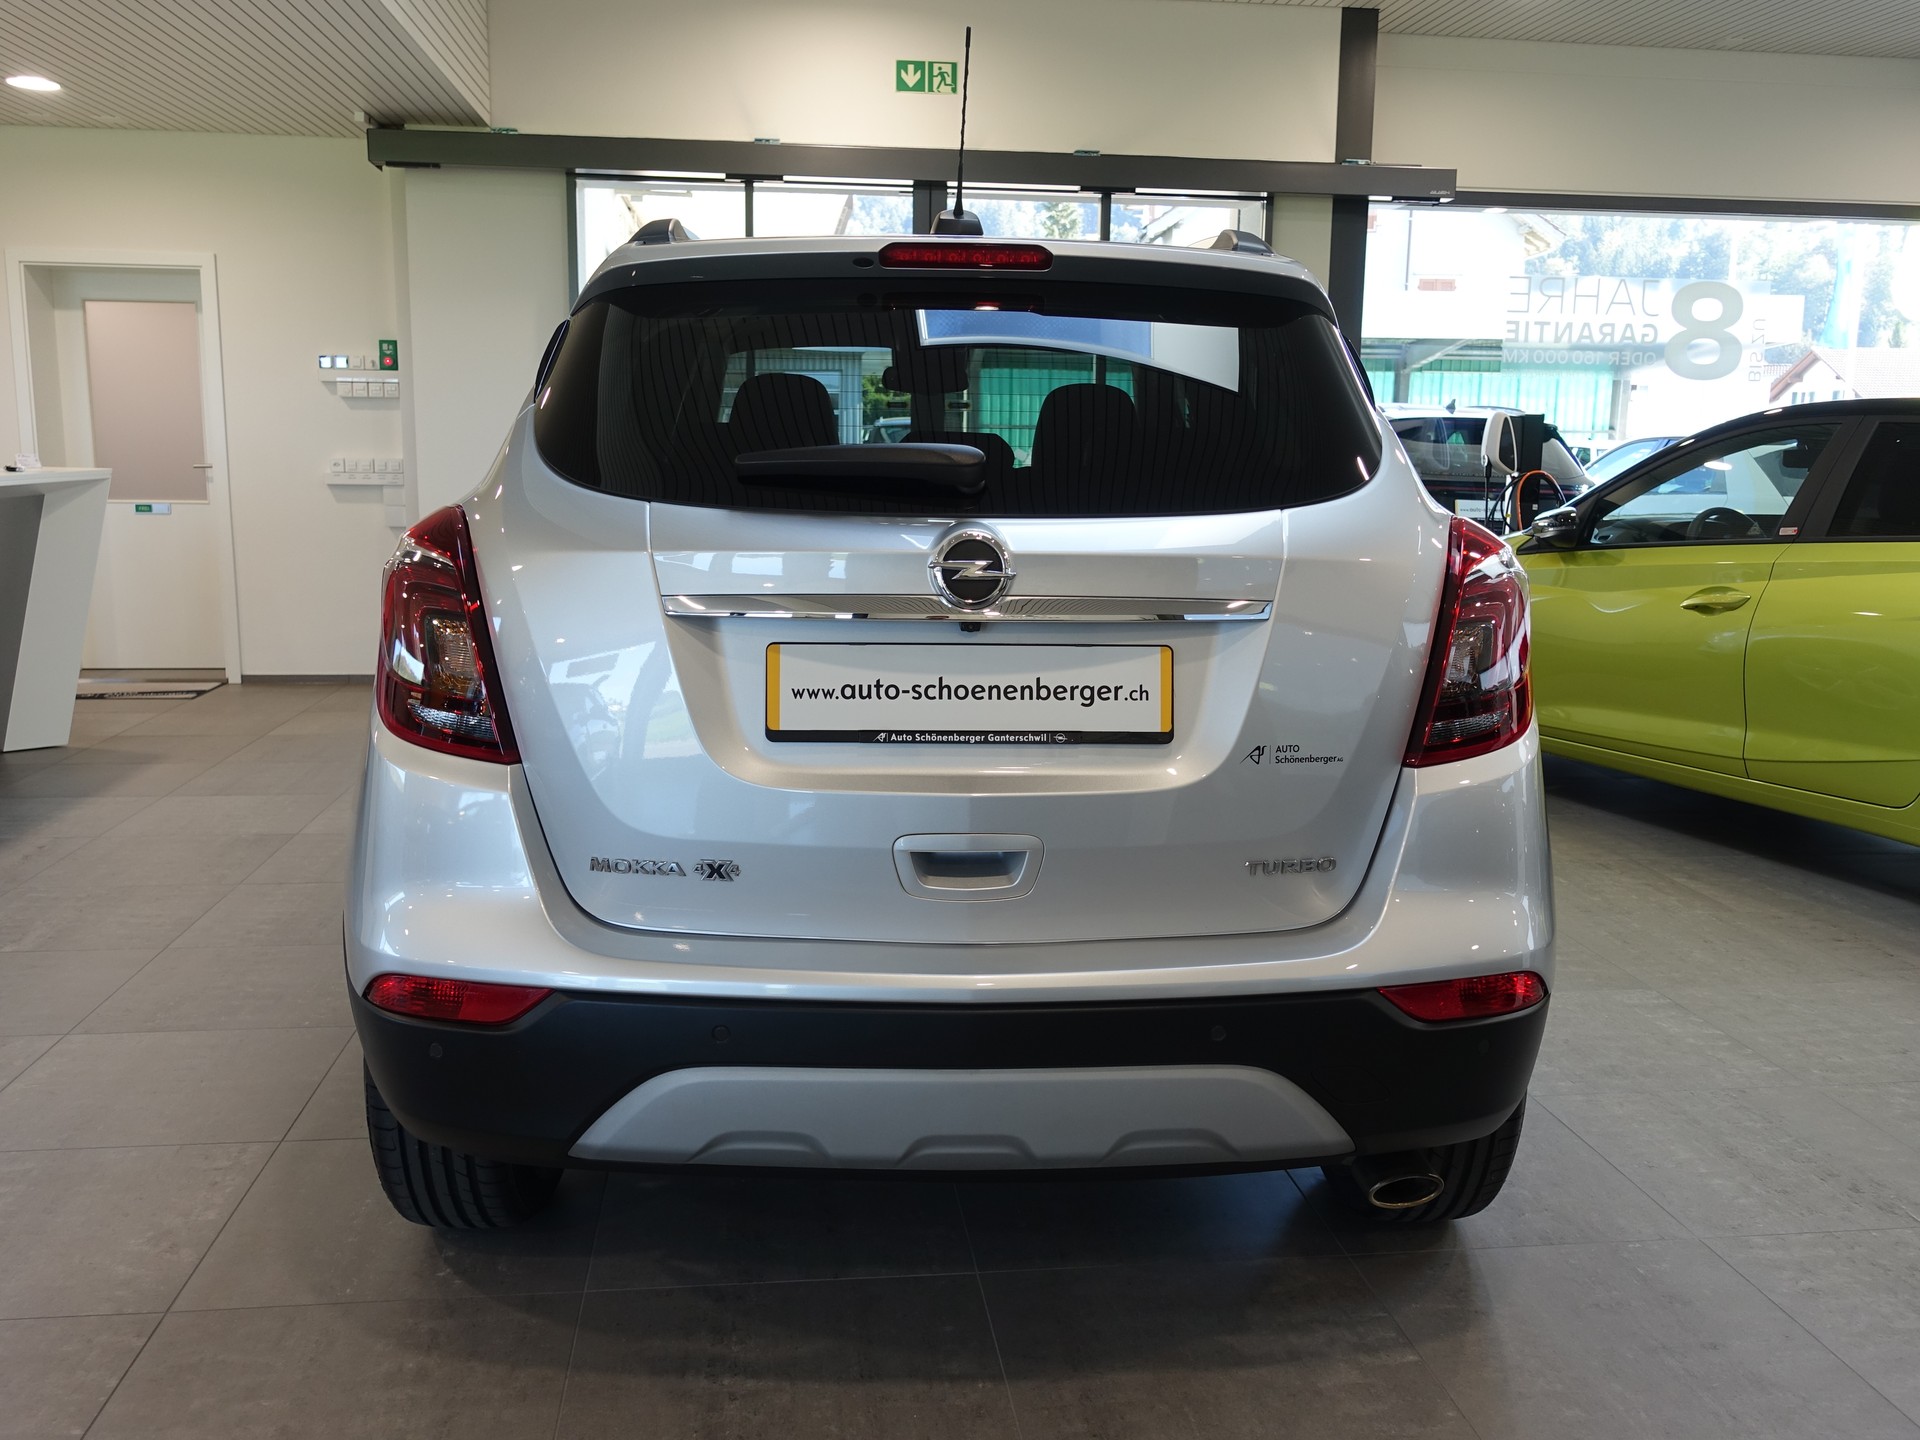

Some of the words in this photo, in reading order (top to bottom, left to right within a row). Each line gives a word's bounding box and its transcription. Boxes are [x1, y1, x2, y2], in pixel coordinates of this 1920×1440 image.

[790, 676, 1150, 708] www.auto-schoenenberger.ch
[890, 733, 913, 742] Auto
[915, 732, 985, 744] Schönenberger
[987, 733, 1047, 743] Ganterschwil
[1275, 745, 1300, 754] AUTO
[1275, 754, 1337, 765] Schönenberger
[589, 856, 687, 877] MOKKA
[1244, 856, 1337, 876] TURBO
